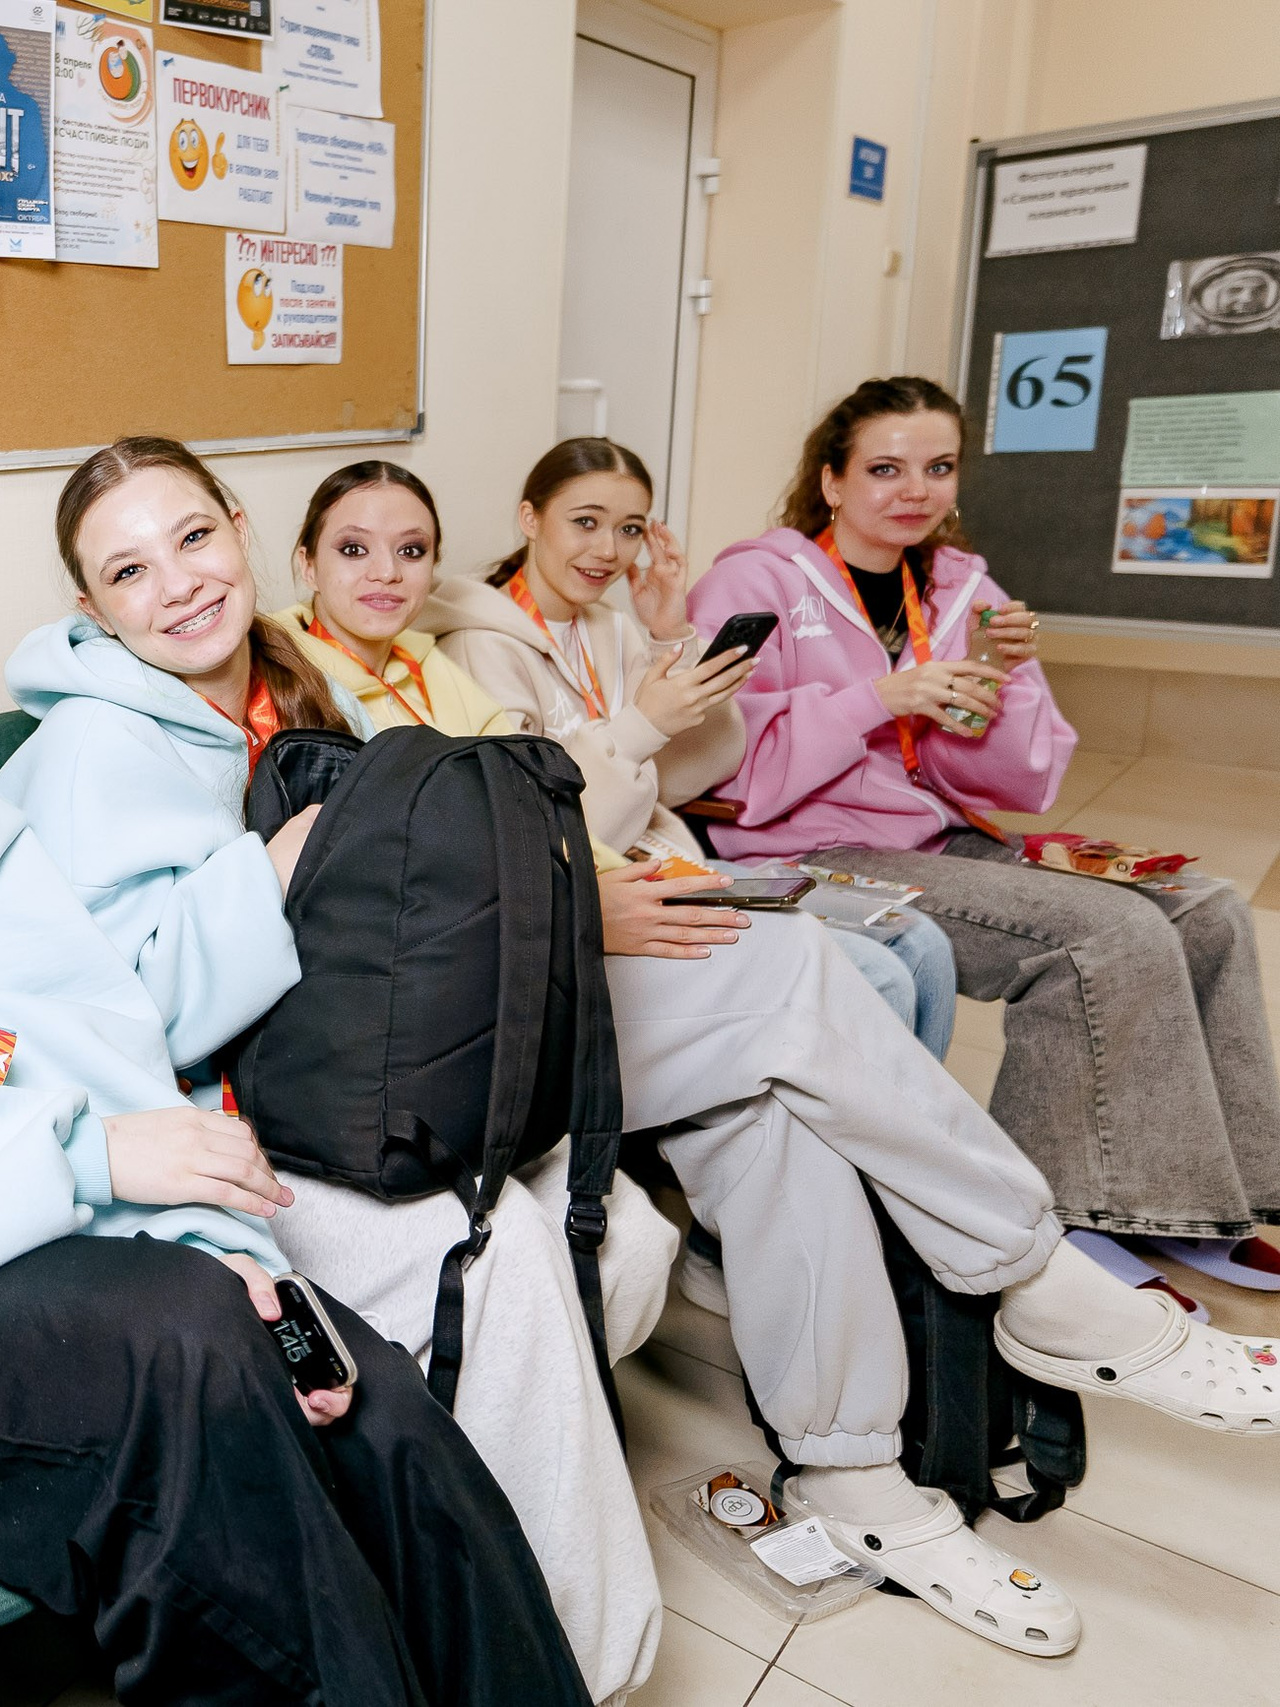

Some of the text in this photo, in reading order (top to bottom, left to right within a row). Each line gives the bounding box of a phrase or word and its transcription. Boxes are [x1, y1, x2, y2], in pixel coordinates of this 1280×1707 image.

[64, 57, 92, 69] апреля
[173, 77, 271, 121] ПЕРВОКУРСНИК
[62, 119, 93, 129] фестиваль
[55, 126, 149, 150] «СЧАСТЛИВЫЕ ЛЮДИ»
[237, 134, 269, 152] ДЛЯ ТЕБЯ
[1061, 182, 1129, 198] красивая
[18, 213, 49, 223] ОКТЯБРЬ
[237, 234, 336, 267] ??? ИНТЕРЕСНО ???
[291, 280, 325, 294] Подходи
[280, 296, 336, 309] после занятий
[1006, 354, 1095, 410] 65
